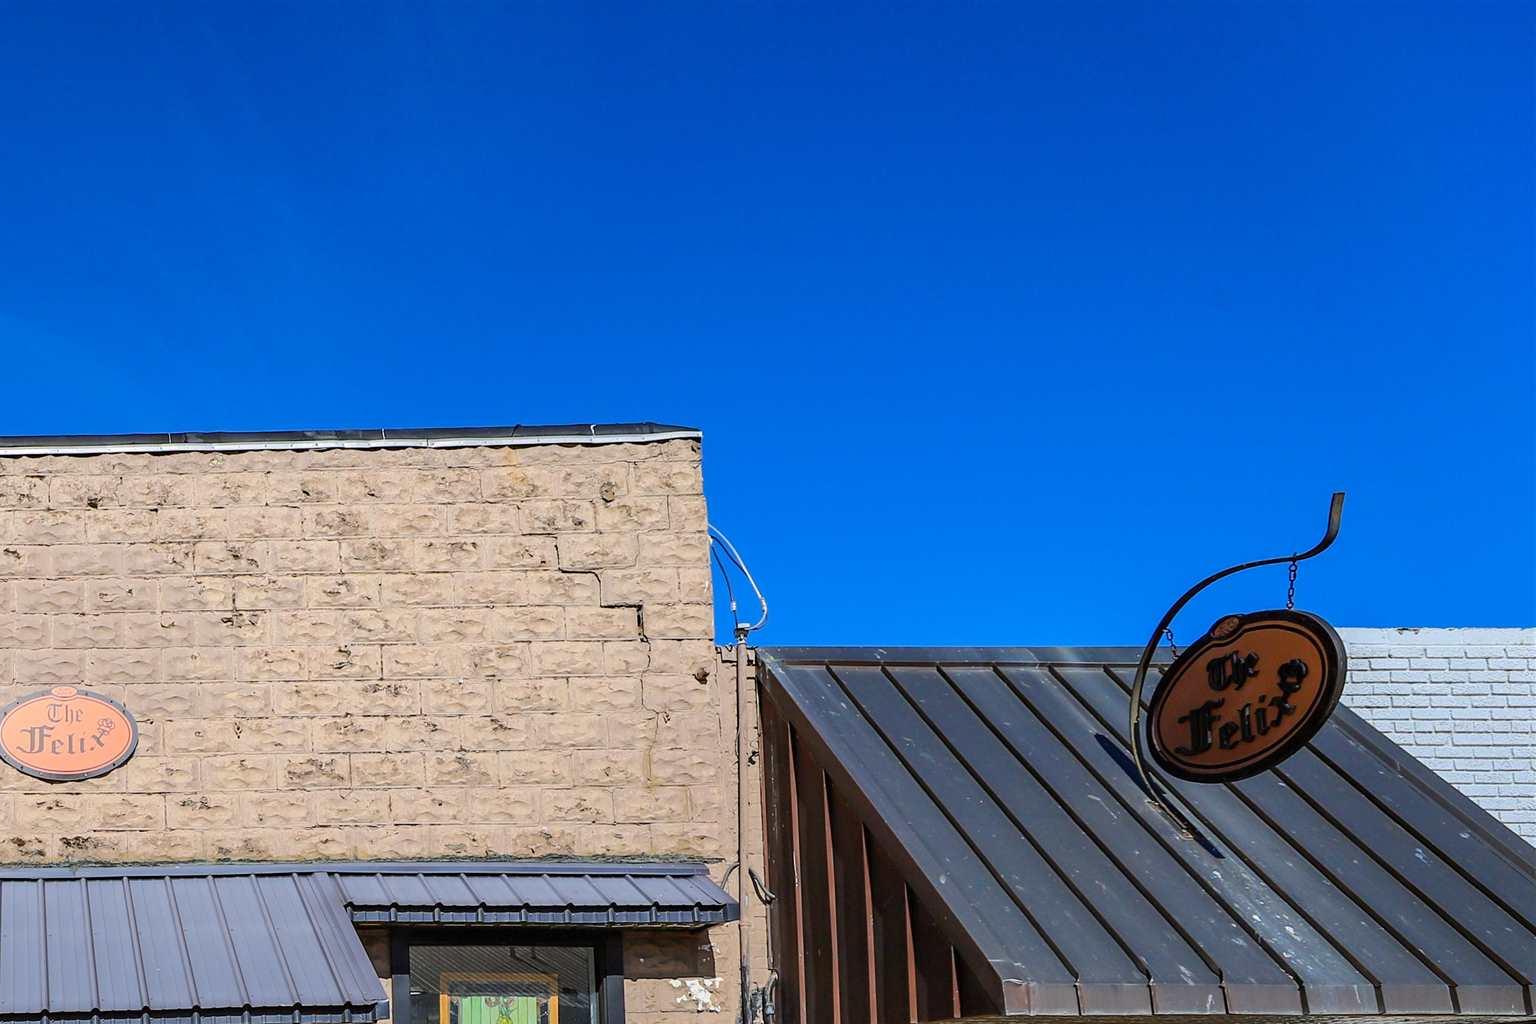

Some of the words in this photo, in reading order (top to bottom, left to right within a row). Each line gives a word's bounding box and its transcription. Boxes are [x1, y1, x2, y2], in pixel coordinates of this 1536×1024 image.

[1206, 650, 1259, 691] The
[47, 703, 84, 724] The
[1174, 694, 1297, 757] Felix
[16, 725, 106, 755] Felix
